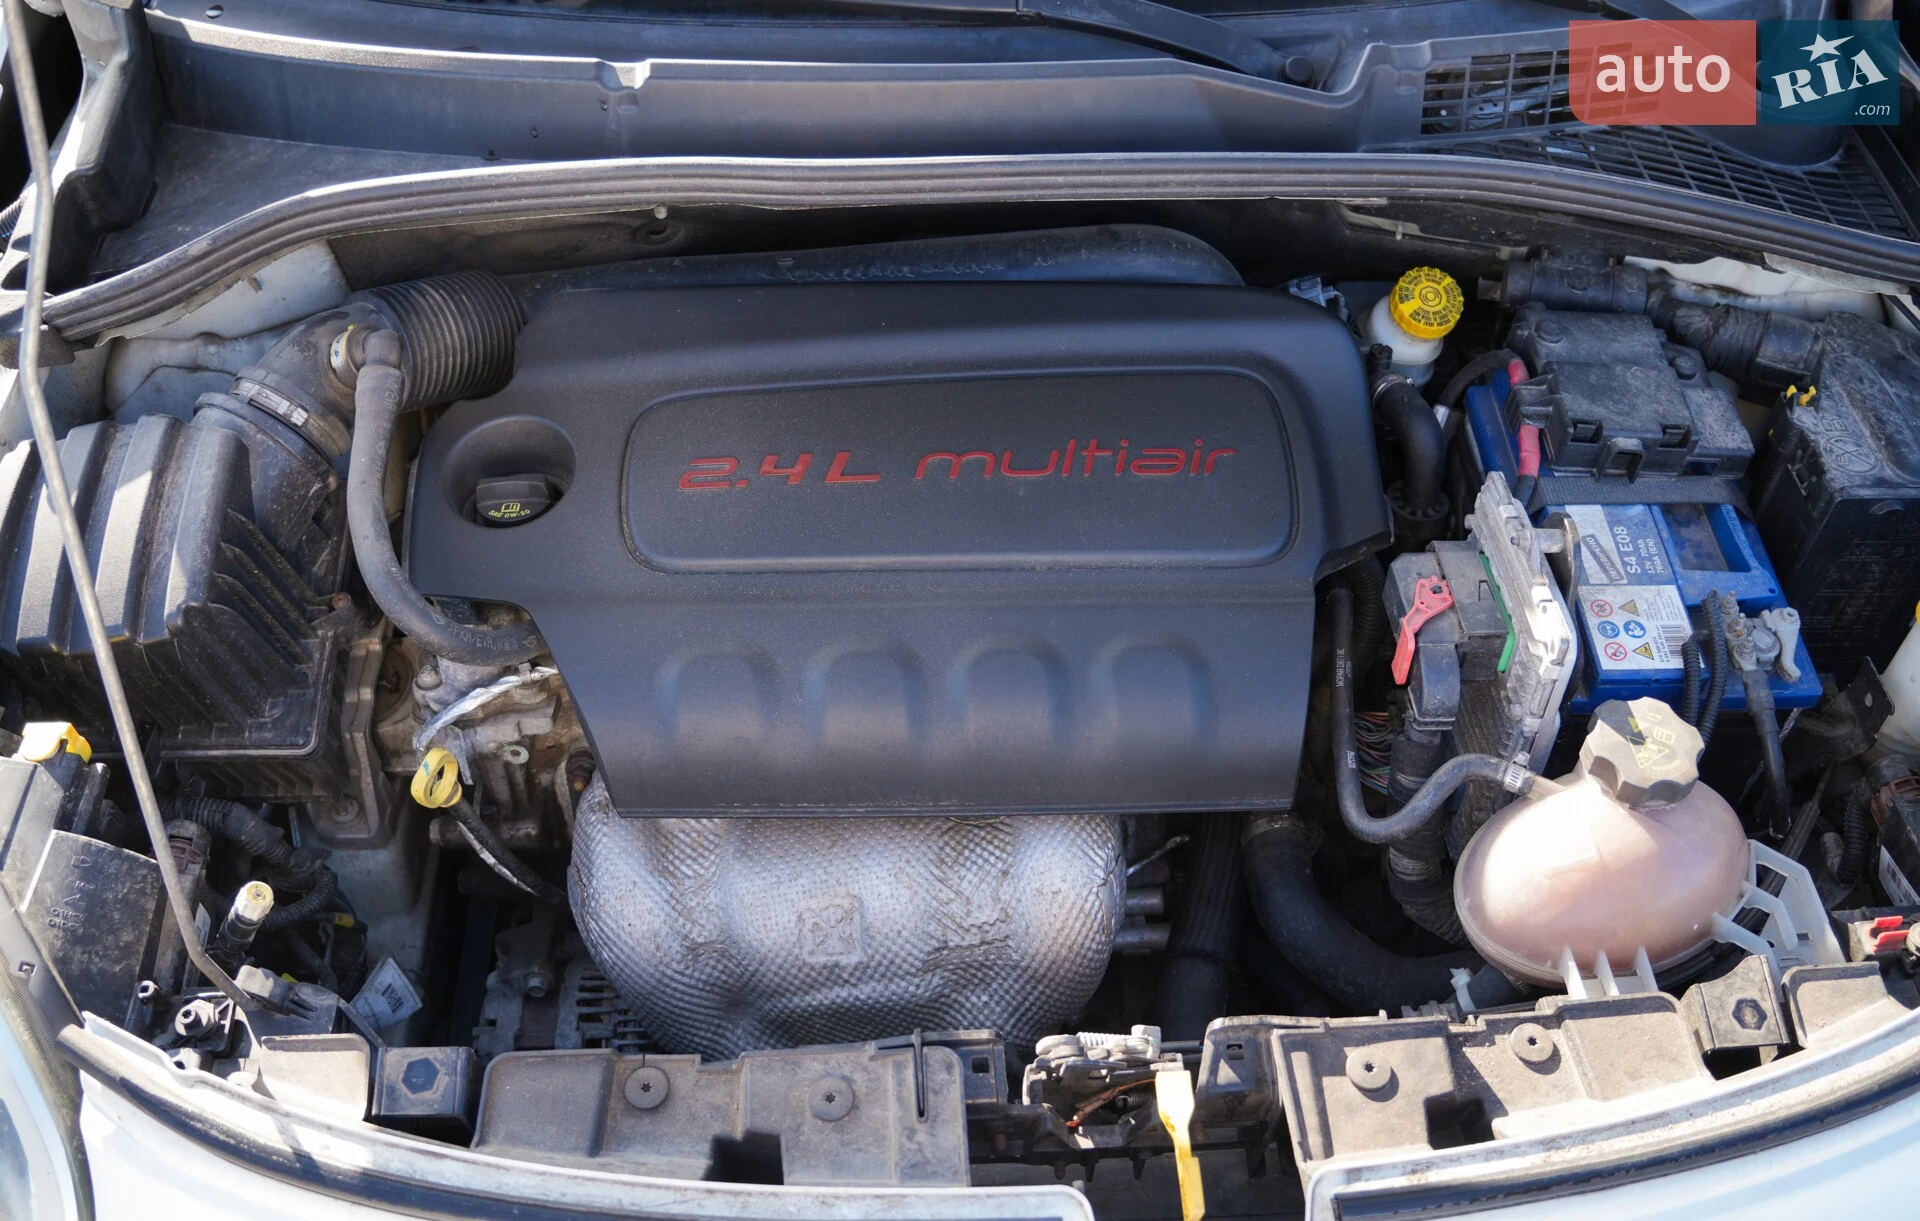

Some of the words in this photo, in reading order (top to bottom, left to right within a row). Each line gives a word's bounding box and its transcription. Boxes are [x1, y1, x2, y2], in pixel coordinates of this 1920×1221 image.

[914, 439, 1237, 481] multiair
[488, 509, 504, 518] SAE
[504, 509, 531, 518] 0W-20
[1613, 526, 1633, 552] E08
[1646, 538, 1660, 555] (EN)
[1636, 539, 1649, 558] 70Ah
[1585, 537, 1621, 582] ПЕРЕВІРЕНО
[1622, 556, 1641, 574] S4
[1645, 561, 1655, 574] 12V
